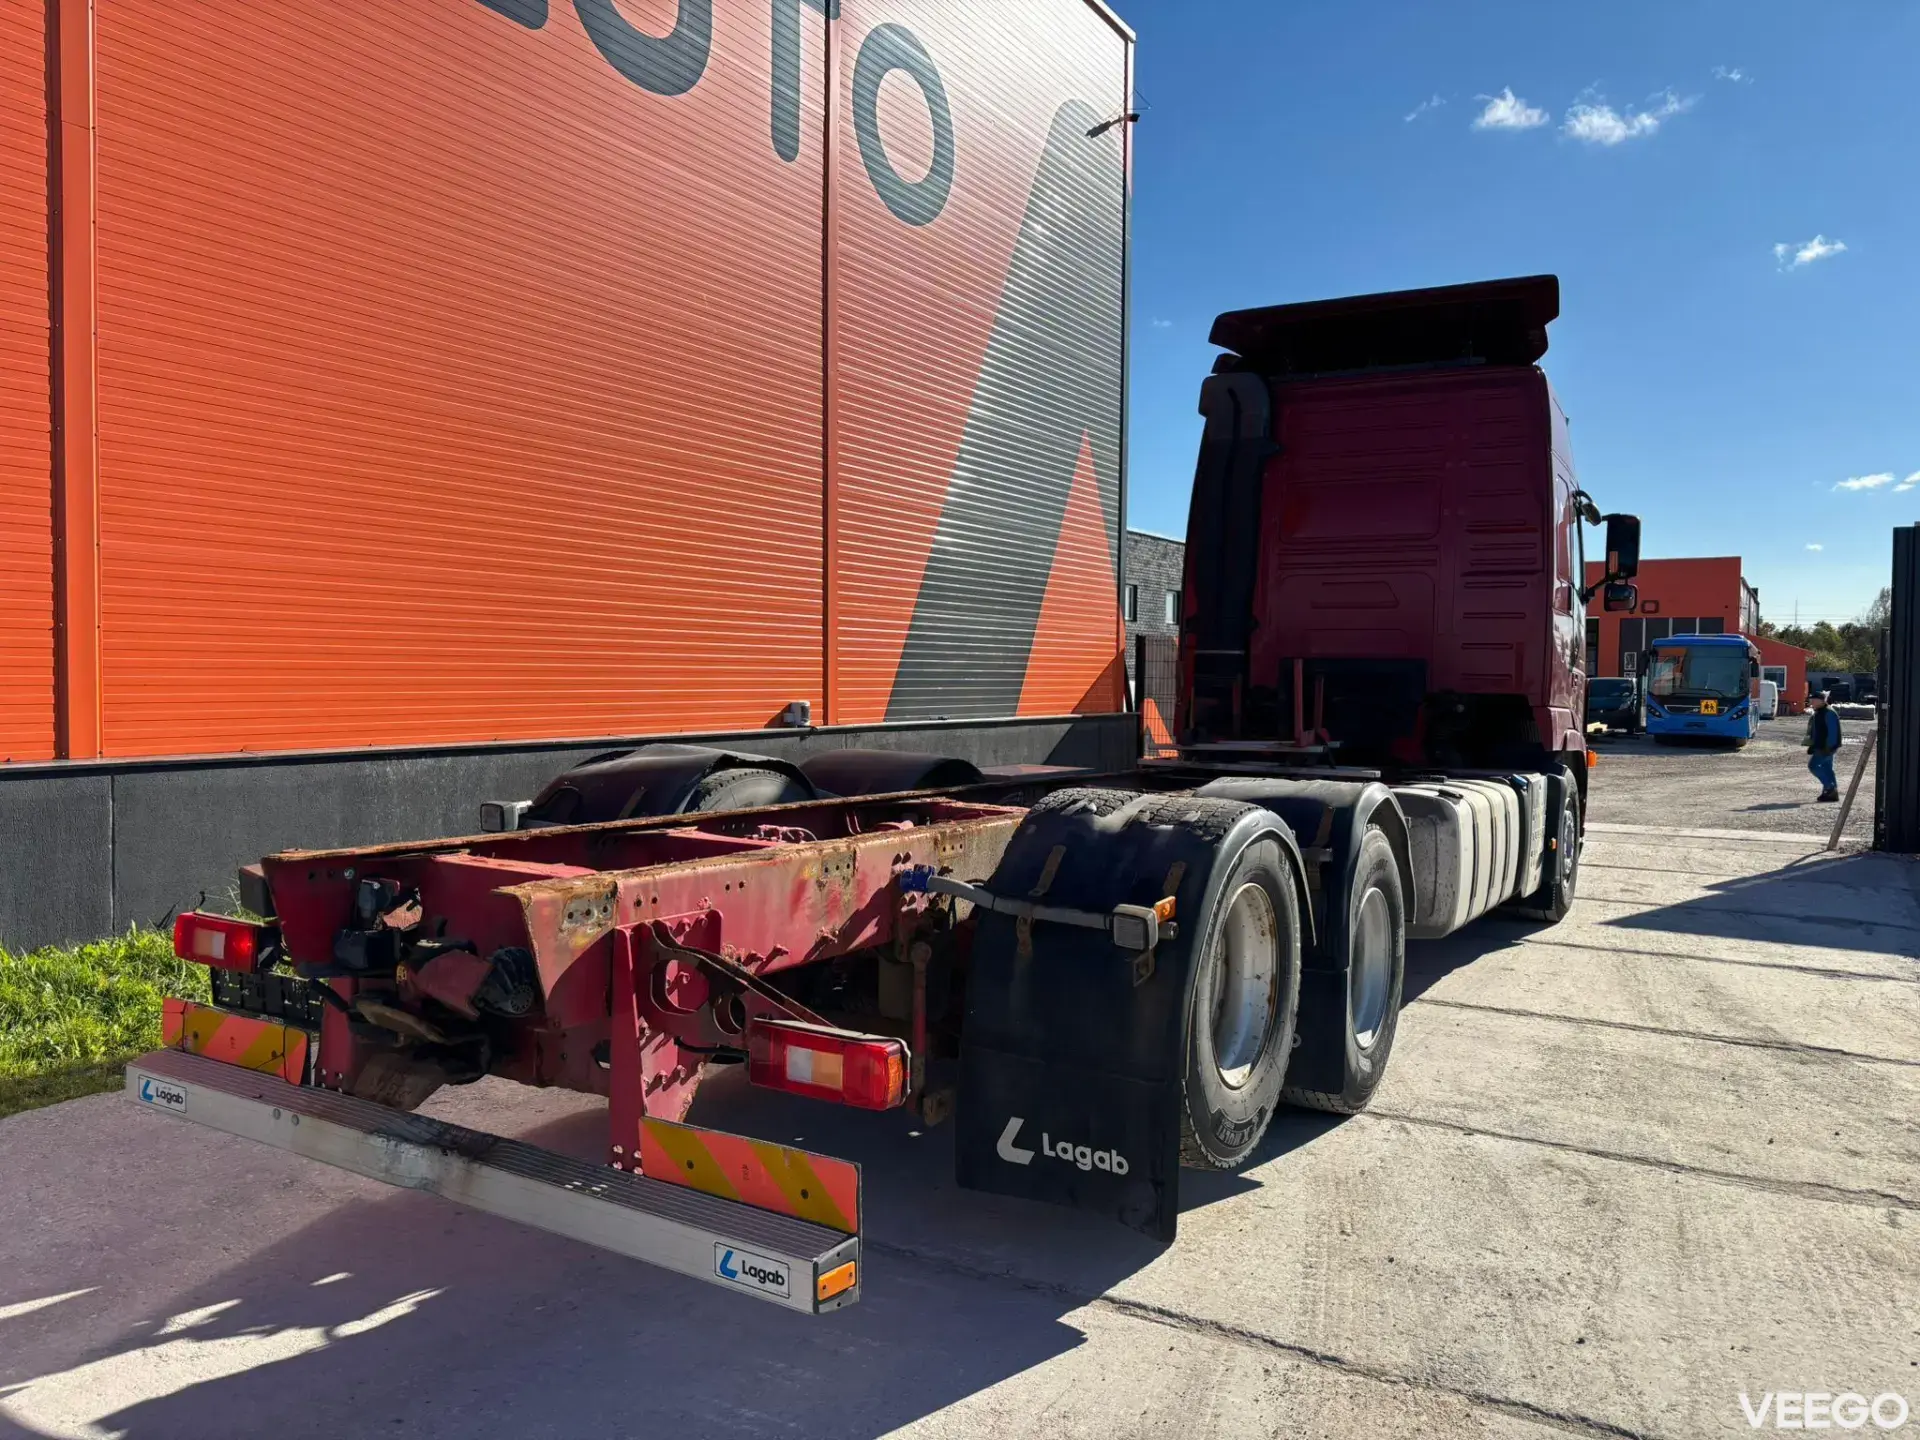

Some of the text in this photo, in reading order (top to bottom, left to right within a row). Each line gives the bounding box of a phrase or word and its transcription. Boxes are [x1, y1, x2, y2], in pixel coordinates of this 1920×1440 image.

[156, 1086, 184, 1105] Lagab
[1042, 1132, 1129, 1175] Lagab
[741, 1260, 785, 1286] Lagab
